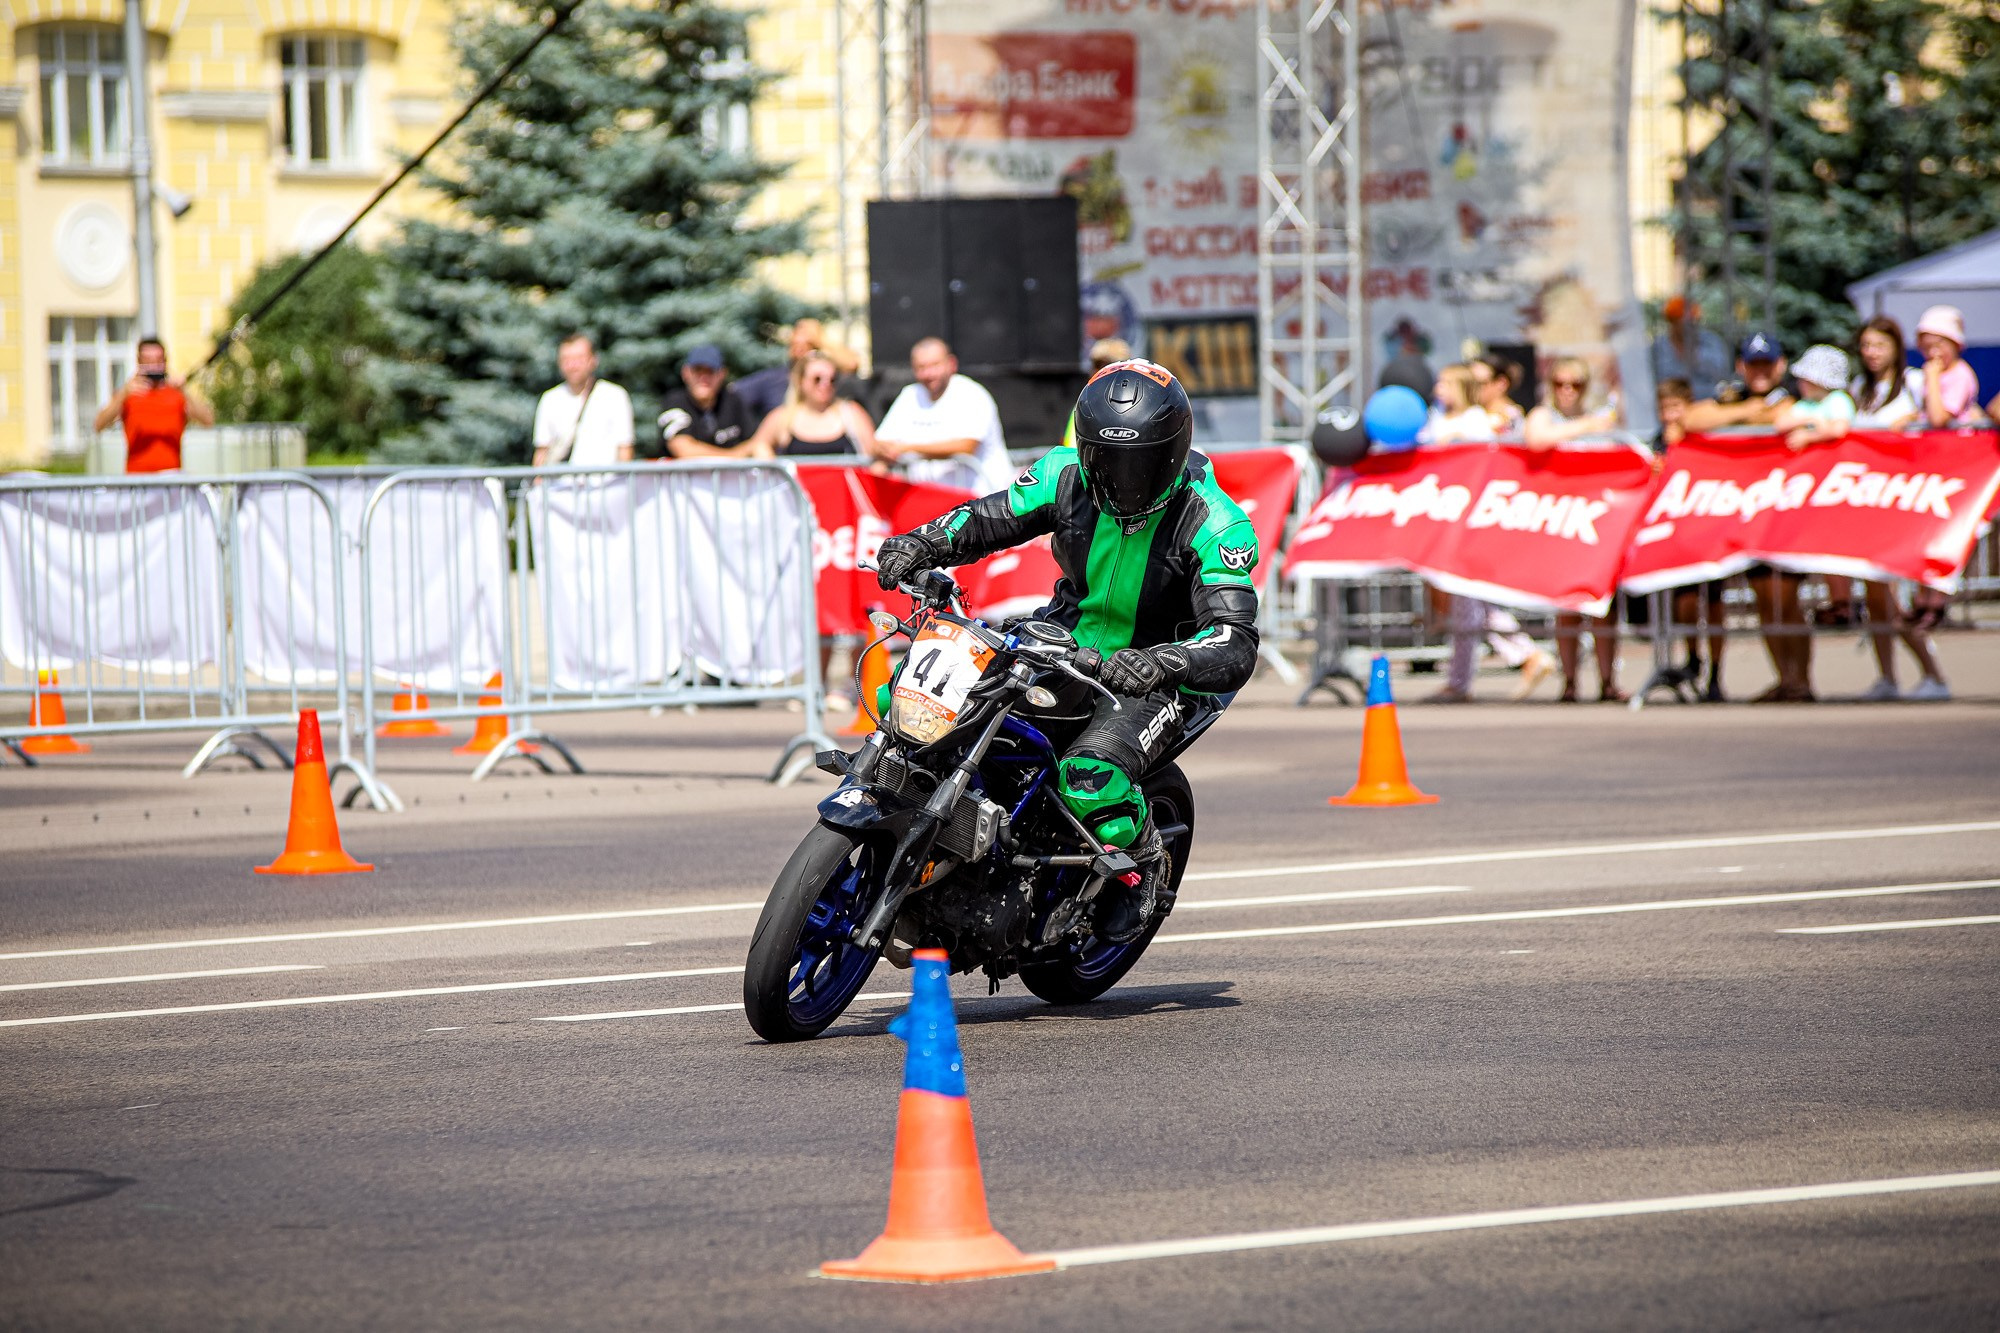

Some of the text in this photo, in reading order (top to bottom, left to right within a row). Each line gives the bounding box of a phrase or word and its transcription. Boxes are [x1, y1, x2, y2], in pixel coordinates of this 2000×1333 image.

[1314, 473, 1611, 545] Альфа Банк
[1643, 461, 1967, 524] Альфа Банк
[895, 687, 952, 719] СМОЛЕНСК
